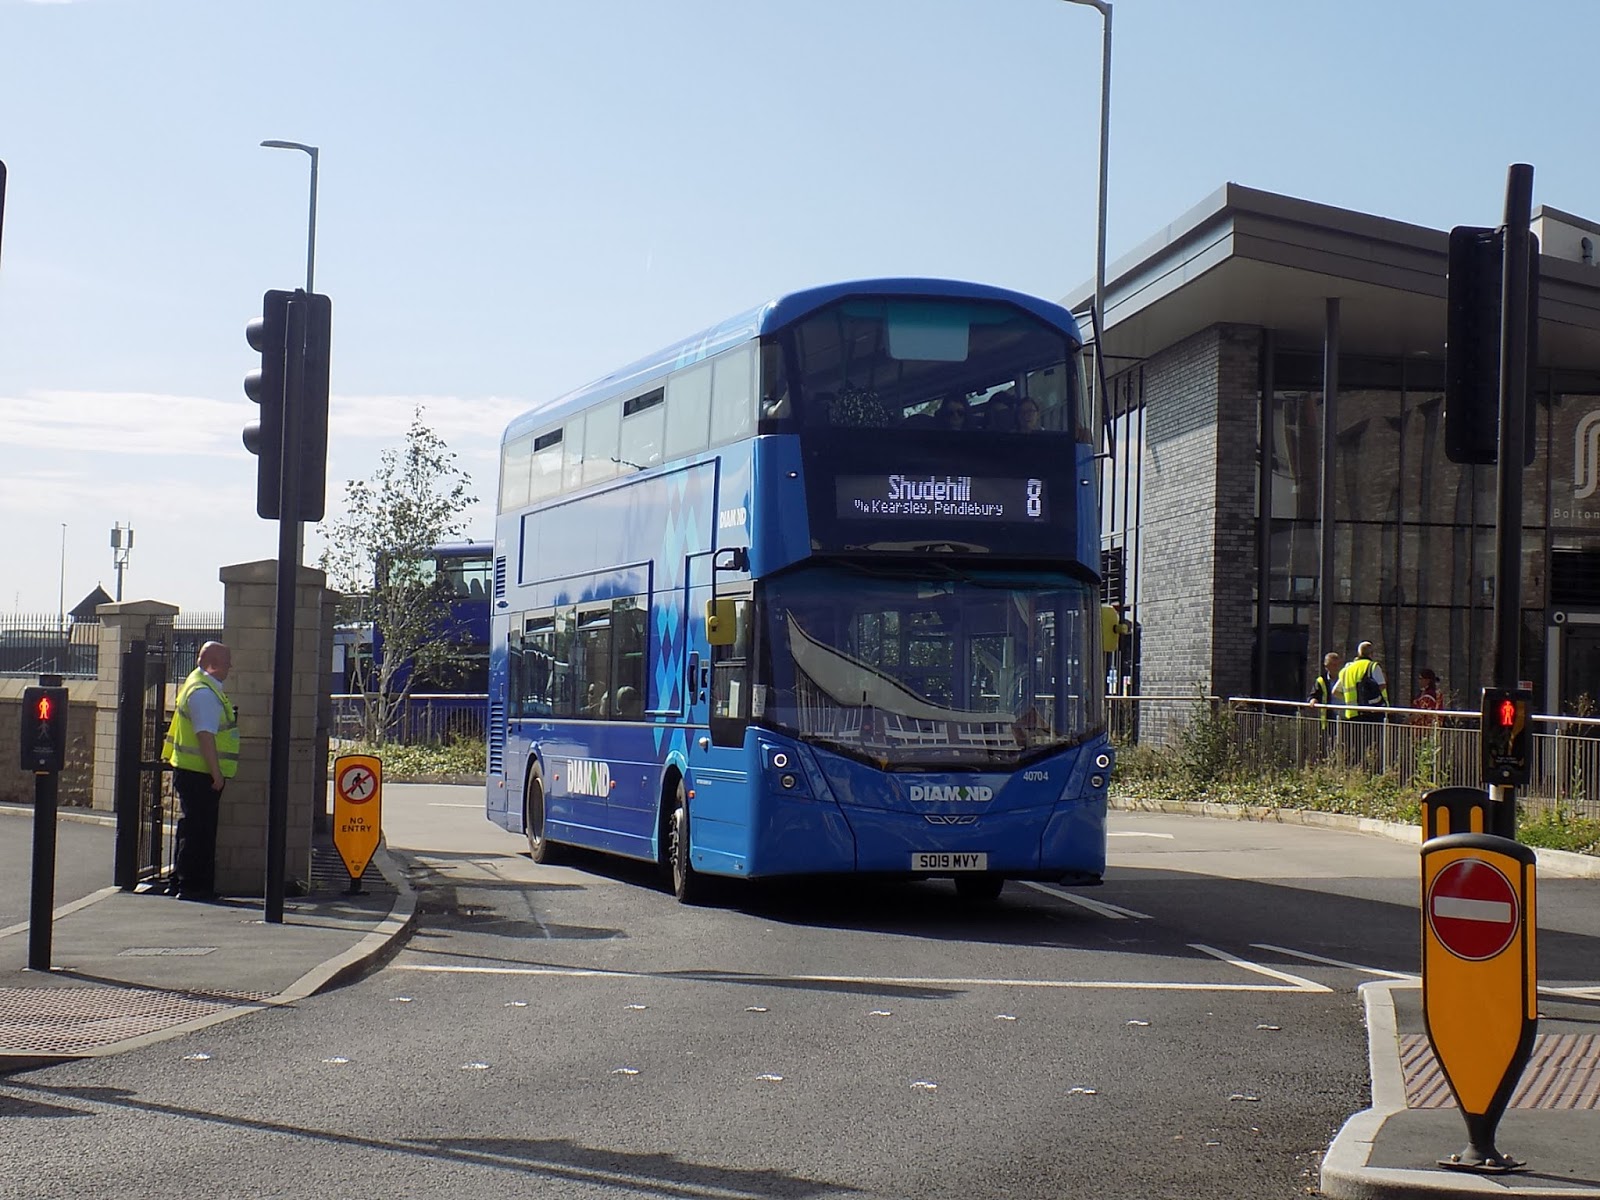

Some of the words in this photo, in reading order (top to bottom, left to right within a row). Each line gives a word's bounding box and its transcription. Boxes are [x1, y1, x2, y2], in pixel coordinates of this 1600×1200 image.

[889, 475, 971, 501] Shudehill
[1027, 478, 1042, 517] 8
[872, 500, 931, 515] Kearsley,
[935, 501, 1003, 516] Pendlebury
[1553, 508, 1600, 519] Bolton
[1023, 771, 1049, 781] 40704
[920, 855, 950, 868] SO19
[953, 855, 979, 868] MVY
